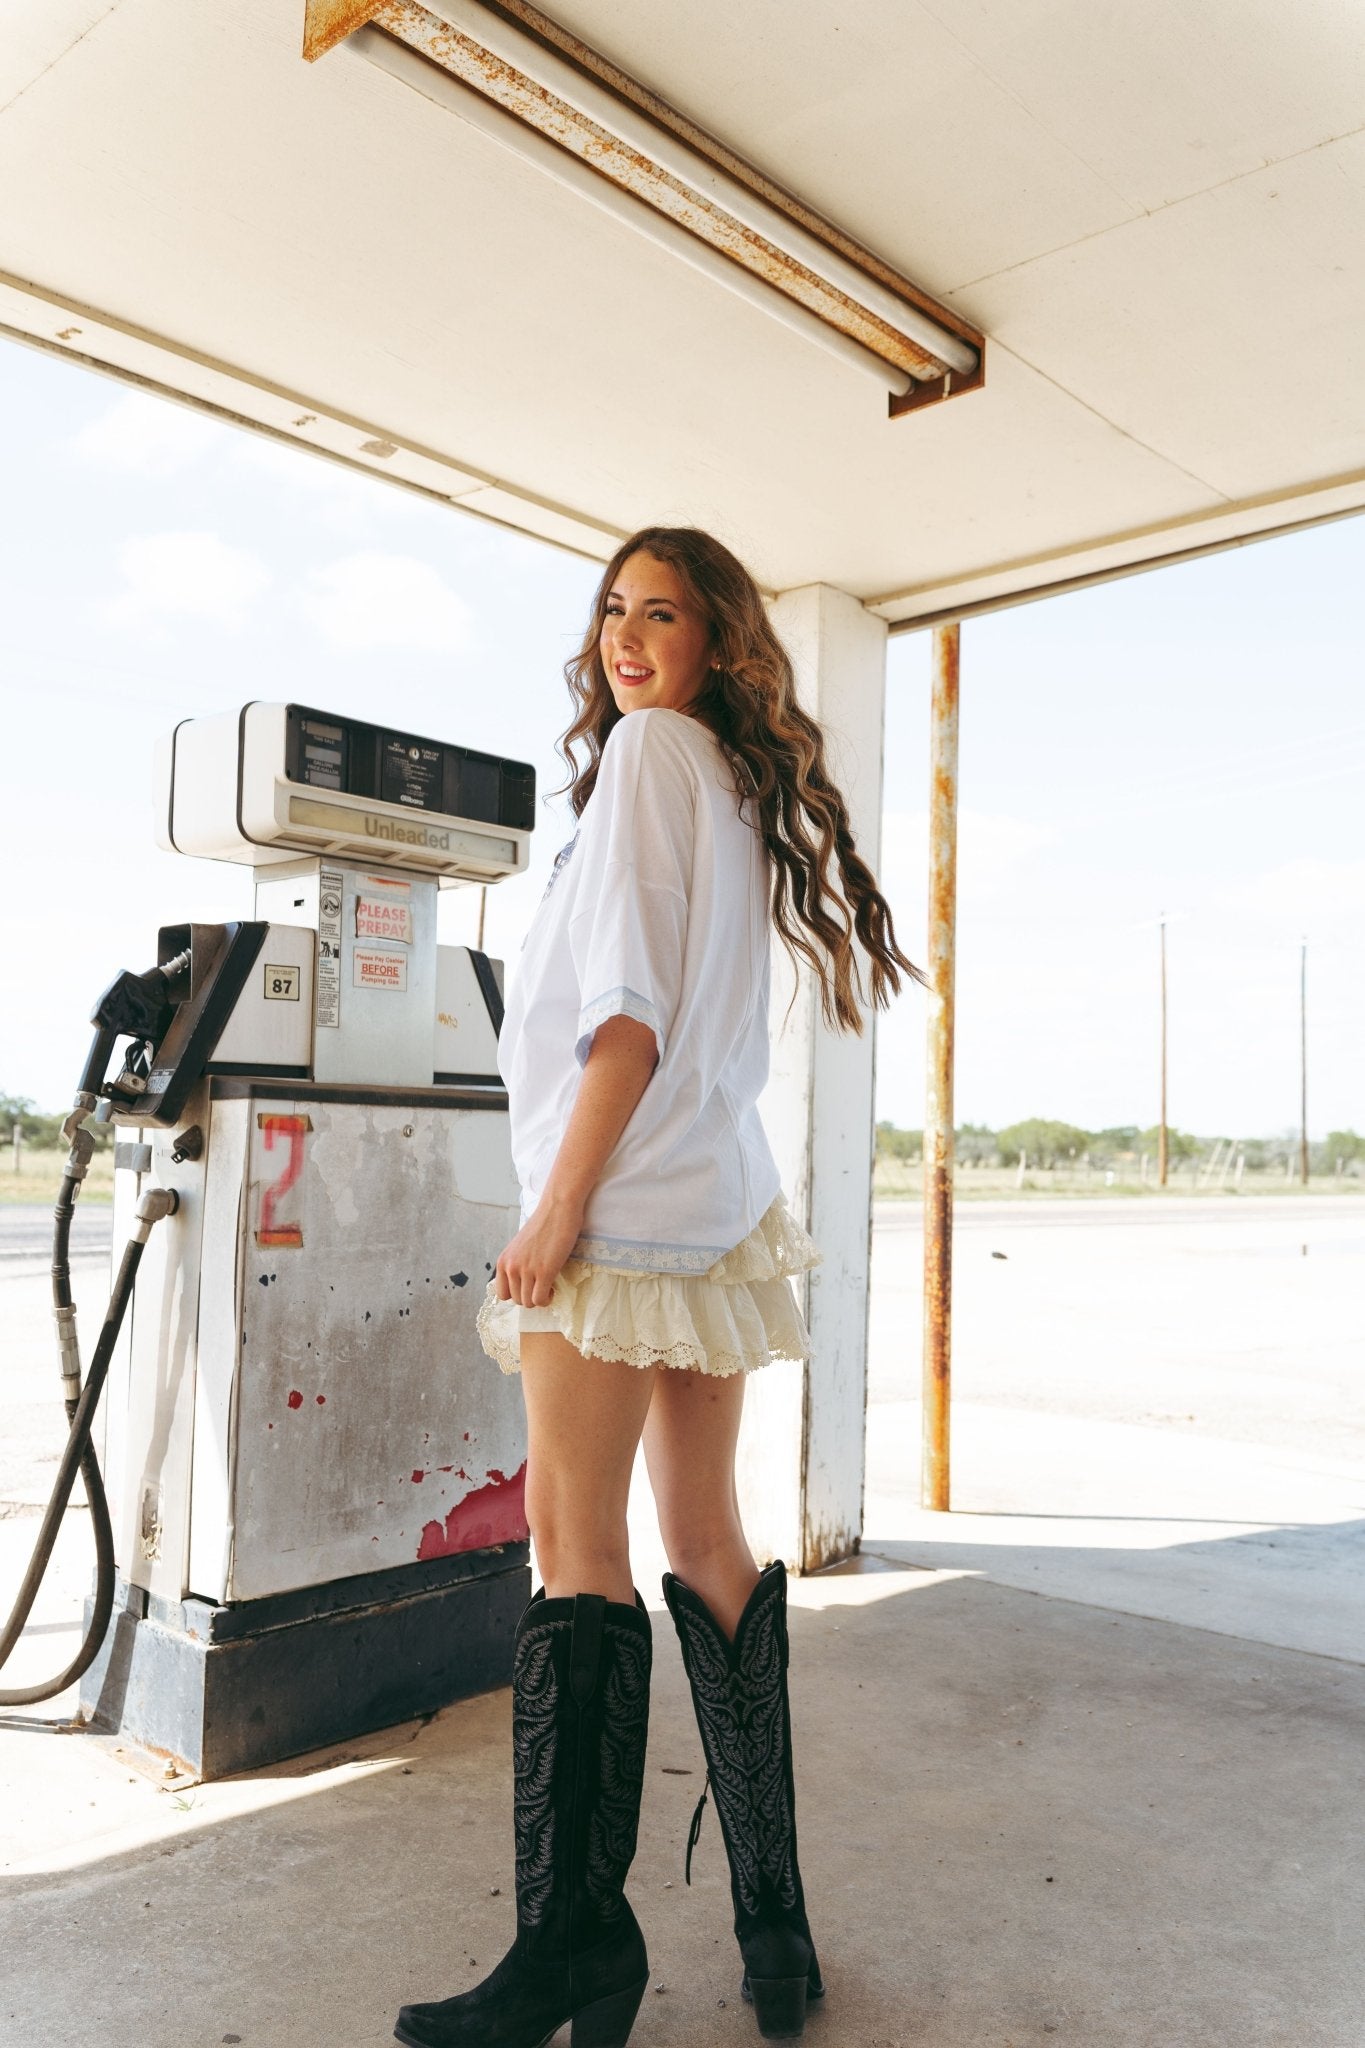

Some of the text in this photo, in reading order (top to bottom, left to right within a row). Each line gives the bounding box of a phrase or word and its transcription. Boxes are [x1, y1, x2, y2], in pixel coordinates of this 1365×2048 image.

[365, 816, 450, 850] Unleaded
[359, 903, 407, 921] PLEASE
[358, 919, 407, 938] PREPAY
[375, 956, 384, 964] Pay
[362, 963, 399, 976] BEFORE
[272, 978, 292, 994] 87
[361, 976, 387, 985] Pumping
[262, 1116, 305, 1246] 2
